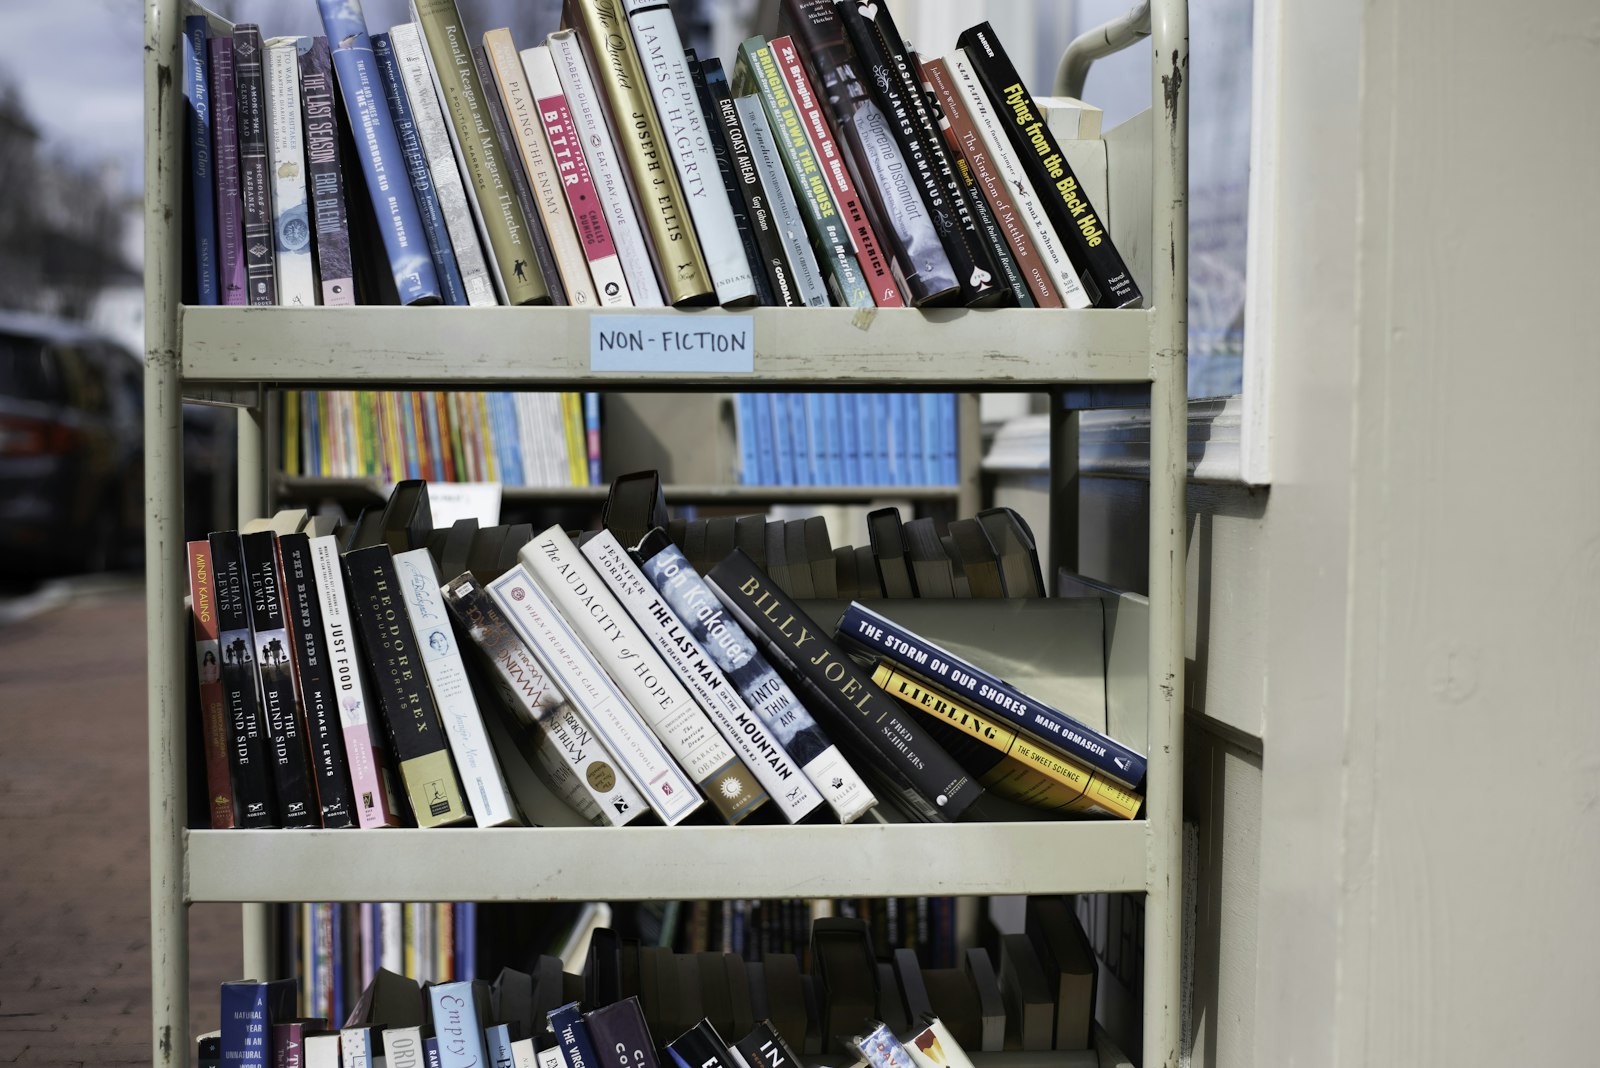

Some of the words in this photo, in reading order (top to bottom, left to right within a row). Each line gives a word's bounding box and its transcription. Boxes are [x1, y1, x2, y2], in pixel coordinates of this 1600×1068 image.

[594, 0, 620, 28] The
[193, 29, 203, 55] Gems
[445, 23, 467, 66] Ronald
[603, 32, 633, 90] Quartet
[638, 25, 672, 83] JAMES
[976, 31, 994, 58] HARDER
[192, 57, 204, 81] from
[302, 72, 325, 91] THE
[456, 67, 480, 110] Reagan
[560, 42, 582, 90] ELIZABETH
[577, 92, 596, 130] GILBERT
[196, 84, 205, 99] the
[284, 53, 290, 63] TO
[288, 110, 296, 149] WHITAKER
[306, 94, 331, 119] LAST
[354, 89, 366, 107] THE
[661, 86, 676, 104] C.
[672, 61, 687, 88] THE
[681, 92, 701, 134] DIARY
[694, 136, 708, 154] OF
[196, 102, 206, 133] Crown
[472, 110, 488, 134] and
[756, 46, 789, 108] BRINGING
[781, 108, 805, 147] DOWN
[798, 150, 816, 174] THE
[808, 174, 834, 218] HOUSE
[196, 137, 207, 148] of
[308, 121, 335, 163] SEASON
[359, 108, 384, 173] THUNDERBOLT
[399, 122, 428, 192] BATTLEFIELD
[452, 96, 470, 141] POLITICAL
[468, 146, 486, 189] MARRIAGE
[509, 82, 533, 136] PLAYING
[527, 140, 543, 166] THE
[537, 172, 558, 214] ENEMY
[543, 110, 578, 186] BETTER
[560, 106, 576, 146] SMARTER
[574, 152, 588, 182] FASTER
[632, 112, 660, 171] JOSEPH
[668, 108, 706, 197] HAGERTY
[719, 97, 738, 128] ENEMY
[729, 127, 747, 155] COAST
[738, 154, 756, 184] AHEAD
[894, 54, 932, 130] POSITIVELY
[928, 137, 950, 176] FIFTH
[948, 182, 974, 231] STREET
[962, 130, 978, 152] The
[195, 150, 207, 178] Glory
[478, 135, 506, 188] Margaret
[865, 111, 896, 161] Supreme
[887, 162, 922, 220] Discomfort
[972, 154, 1001, 198] Kingdom
[1000, 81, 1037, 127] Flying
[1024, 120, 1055, 156] from
[1042, 152, 1067, 179] the
[1055, 175, 1089, 217] Black
[1076, 213, 1106, 248] Hole
[314, 171, 338, 195] ERIC
[377, 174, 389, 191] KID
[652, 177, 665, 189] J.
[750, 195, 763, 209] Guy
[316, 198, 340, 234] BLEHM
[387, 196, 399, 214] BILL
[498, 191, 524, 244] Thatcher
[657, 194, 682, 240] ELLIS
[755, 208, 770, 230] Gibson
[996, 198, 1009, 210] of
[392, 215, 408, 248] BRYSON
[579, 214, 594, 245] DUHIGG
[588, 209, 605, 243] CHARLES
[1002, 212, 1030, 256] Matthias
[825, 223, 840, 244] Ben
[833, 243, 856, 282] Mezrich
[774, 266, 793, 306] GOODALL
[1032, 268, 1048, 296] OXFORD
[600, 330, 746, 352] NON-FICTION
[195, 554, 206, 583] MINDY
[600, 554, 633, 596] JORDAN
[602, 544, 646, 594] JENNIFER
[198, 587, 209, 622] KALING
[217, 572, 229, 610] LEWIS
[228, 562, 242, 618] MICHAEL
[291, 550, 303, 578] THE
[297, 583, 311, 627] BLIND
[304, 632, 317, 666] SIDE
[655, 550, 690, 587] Jon
[684, 586, 752, 666] Krakauer
[330, 623, 346, 653] JUST
[541, 539, 562, 563] The
[559, 562, 622, 642] AUDACITY
[617, 644, 639, 666] of
[634, 662, 674, 710] HOPE
[370, 596, 390, 648] EDMUND
[388, 658, 407, 709] MORRIS
[374, 566, 412, 680] THEODORE
[409, 694, 428, 732] REX
[525, 603, 545, 628] WHEN
[545, 631, 581, 676] TRUMPETS
[581, 678, 598, 698] CALL
[738, 576, 814, 649] BILLY
[810, 649, 876, 716] JOEL
[337, 658, 352, 690] FOOD
[856, 619, 883, 642] THE
[883, 633, 928, 665] STORM
[929, 658, 949, 675] ON
[949, 668, 977, 690] OUR
[978, 683, 1027, 717] SHORES
[647, 600, 672, 628] THE
[668, 626, 698, 659] LAST
[694, 659, 722, 690] MAN
[720, 690, 729, 700] ON
[727, 699, 737, 711] THE
[736, 713, 792, 780] MOUNTAIN
[658, 636, 668, 648] THE
[667, 648, 682, 666] DEATH
[680, 665, 688, 674] OF
[687, 674, 695, 682] AN
[694, 683, 716, 710] AMERICAN
[715, 710, 743, 744] ADVENTURER
[741, 744, 750, 753] ON
[749, 753, 756, 761] K2
[750, 678, 780, 705] INTO
[765, 694, 790, 717] THIN
[231, 692, 244, 730] BLIND
[246, 714, 256, 738] THE
[562, 709, 592, 746] NORRIS
[780, 711, 796, 728] AIR
[890, 718, 913, 742] FRED
[898, 682, 996, 740] LIEBLING
[237, 736, 248, 764] SIDE
[314, 692, 327, 737] MICHAEL
[322, 744, 333, 776] LEWIS
[692, 743, 720, 765] BARACK
[882, 727, 924, 770] SCHRUERS
[1033, 713, 1061, 733] MARK
[1060, 727, 1107, 758] OBMASCIK
[698, 751, 726, 774] OBAMA
[1017, 745, 1030, 756] THE
[1030, 752, 1052, 768] SWEET
[1052, 763, 1080, 782] SCIENCE
[258, 998, 262, 1006] A
[440, 995, 465, 1056] Empty
